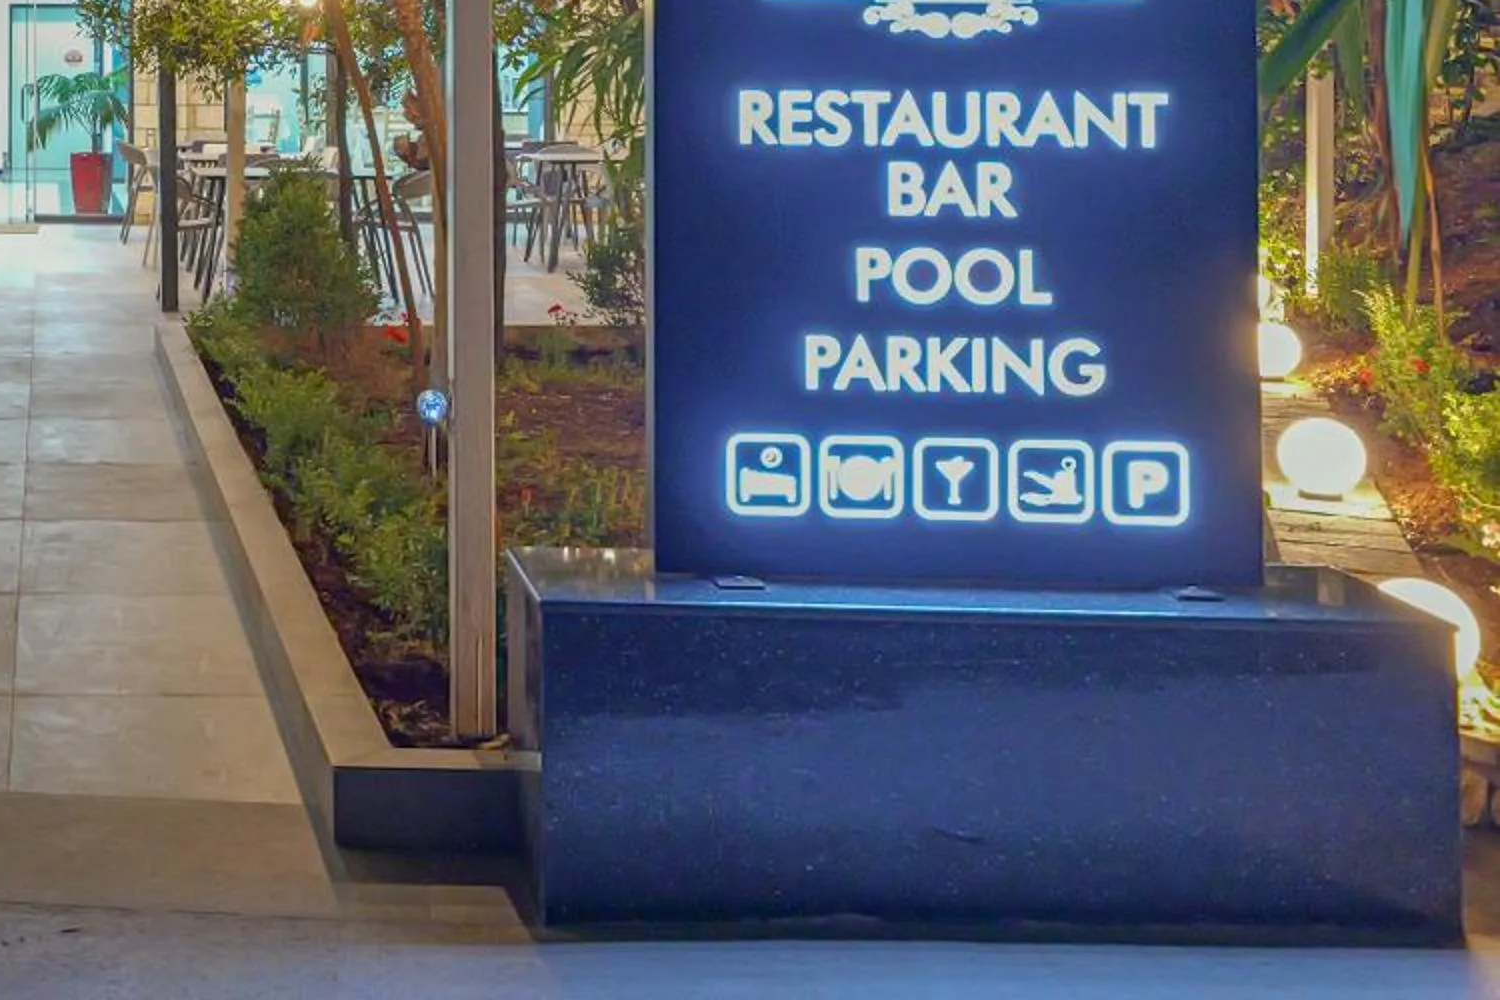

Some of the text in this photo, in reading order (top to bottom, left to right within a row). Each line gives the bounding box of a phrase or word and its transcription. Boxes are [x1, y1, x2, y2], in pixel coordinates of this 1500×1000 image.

[738, 89, 1169, 149] RESTAURANT
[888, 161, 1018, 218] BAR
[855, 246, 1053, 305] POOL
[804, 334, 1108, 396] PARKING
[1127, 461, 1169, 508] P
